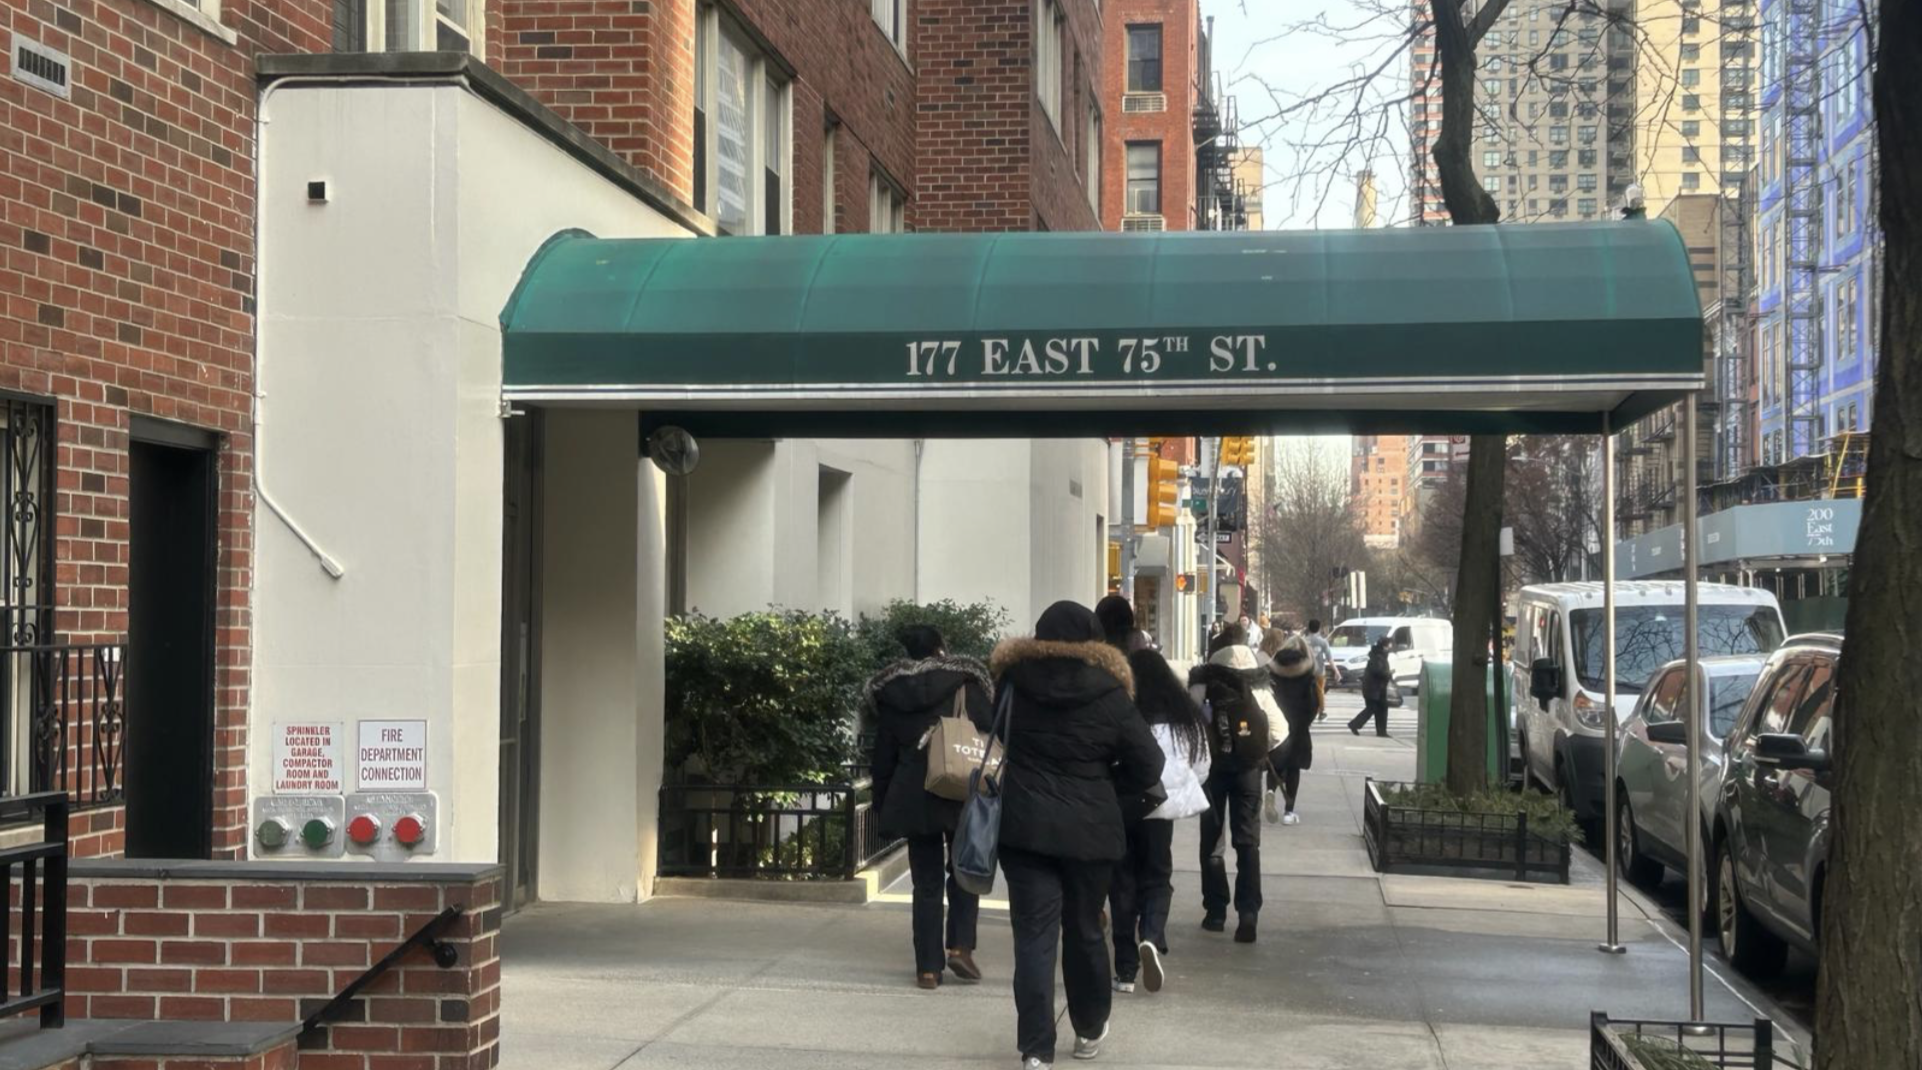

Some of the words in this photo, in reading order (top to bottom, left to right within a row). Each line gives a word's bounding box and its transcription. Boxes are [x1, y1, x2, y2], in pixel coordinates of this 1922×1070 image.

[906, 341, 961, 375] 177
[981, 338, 1099, 374] EAST
[1209, 335, 1277, 372] ST.
[1806, 507, 1834, 521] 200
[1806, 521, 1834, 534] East
[286, 726, 330, 735] SPRINKLER
[381, 729, 403, 742] FIRE
[285, 737, 319, 746] LOCATED
[323, 737, 331, 746] IN
[291, 748, 325, 757] GARAGE,
[361, 748, 423, 761] DEPARTMENT
[283, 759, 333, 768] COMPACTOR
[286, 770, 310, 779] ROOM
[313, 770, 329, 779] AND
[361, 767, 422, 781] CONNECTION
[276, 781, 312, 790] LAUNDRY
[315, 781, 338, 790] ROOM
